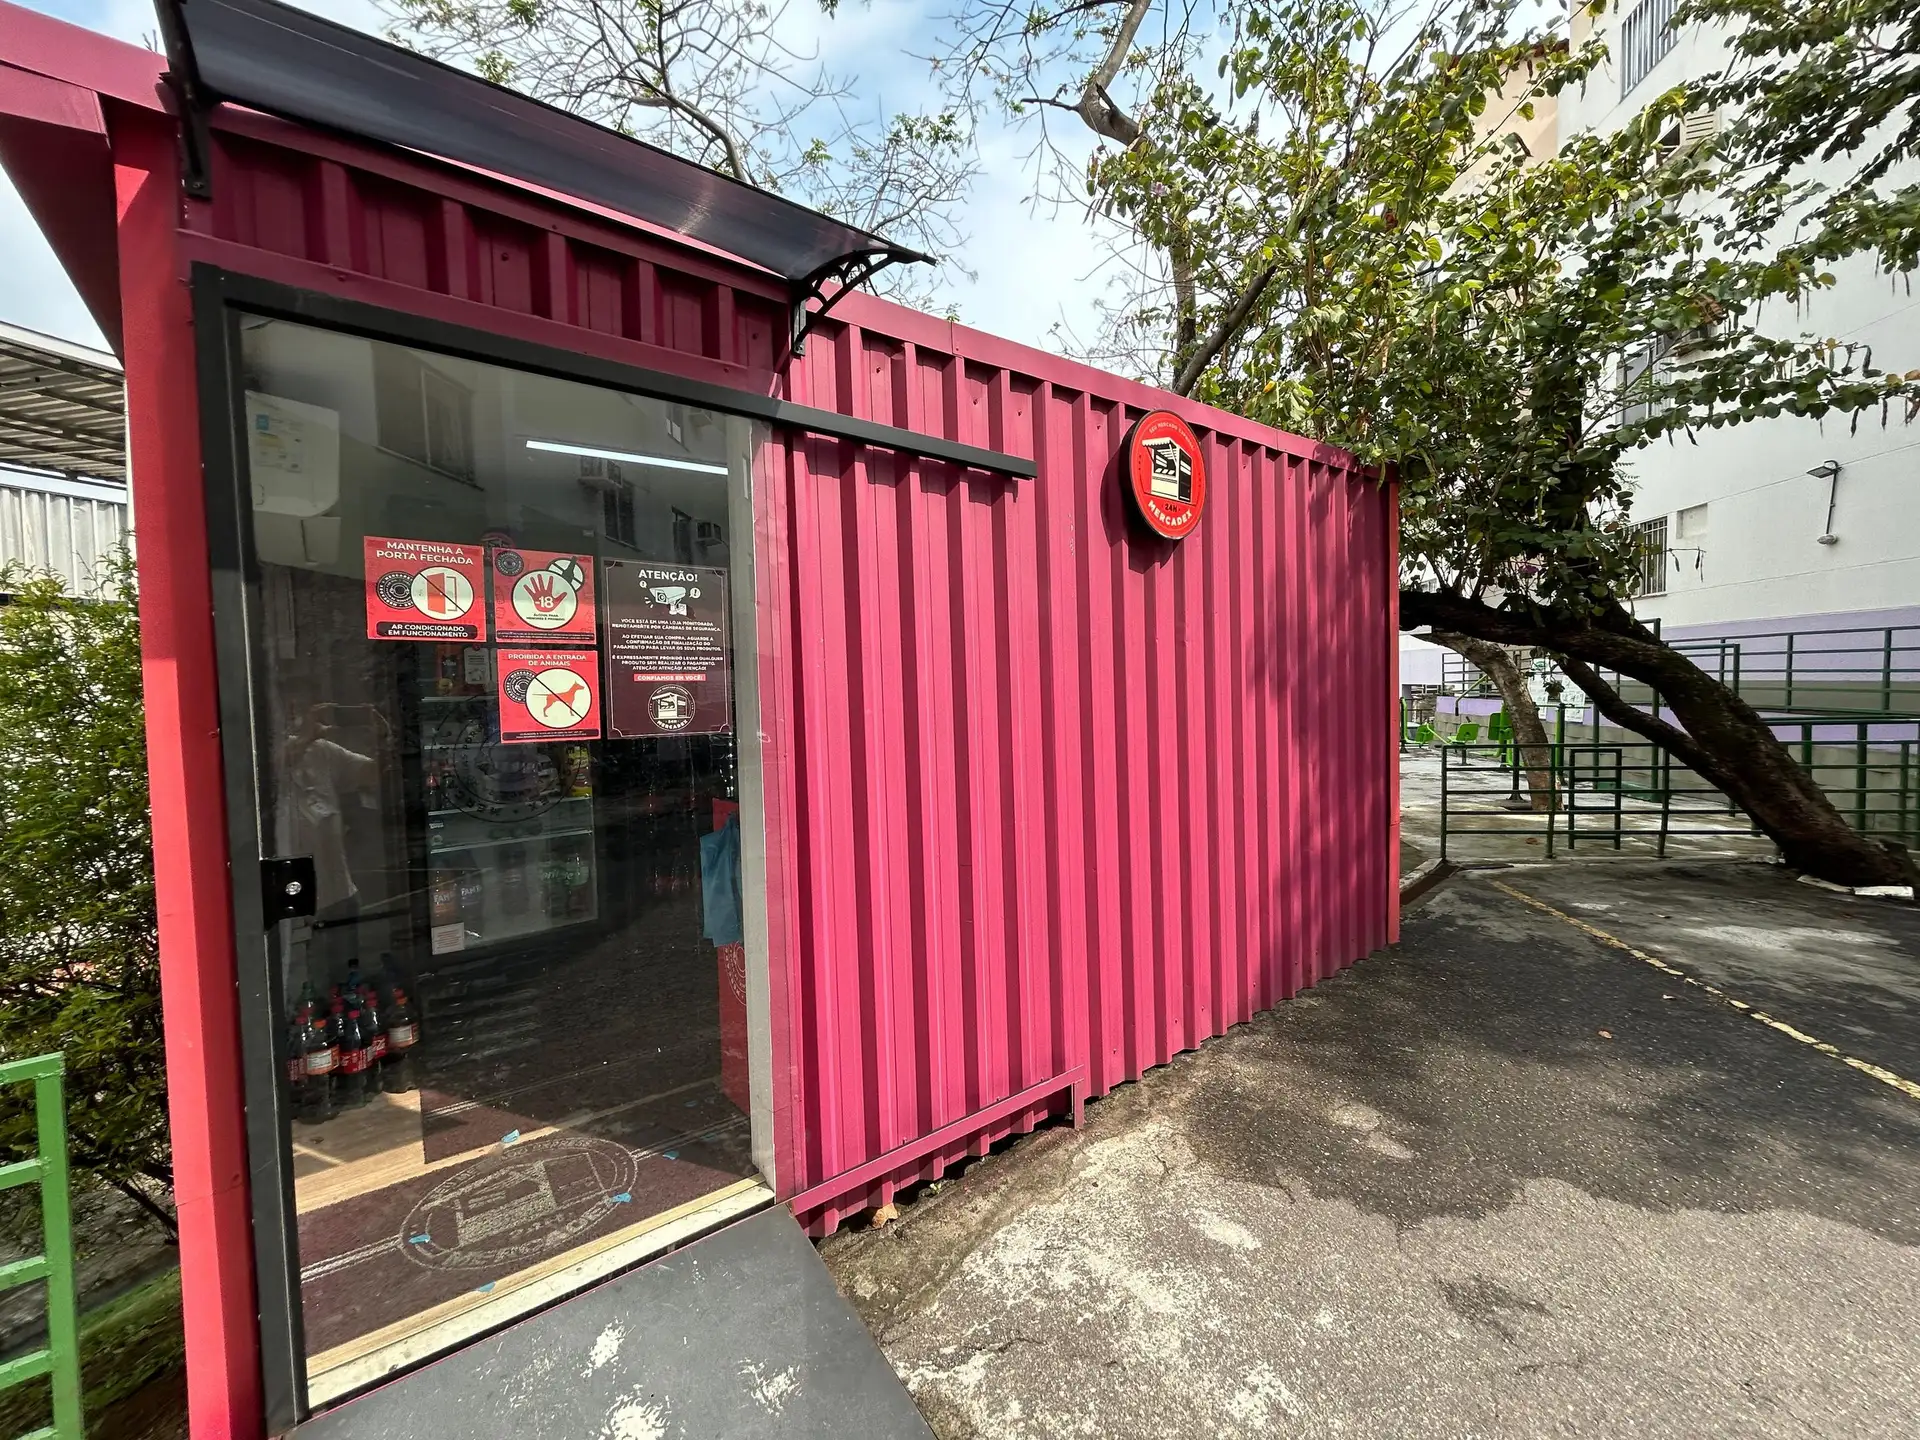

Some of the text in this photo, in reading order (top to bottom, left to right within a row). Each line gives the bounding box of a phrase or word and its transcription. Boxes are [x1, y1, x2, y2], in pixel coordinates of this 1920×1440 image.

[1148, 500, 1192, 526] MERCADEX
[1165, 503, 1178, 512] 24H
[386, 541, 464, 555] MANTENHA A
[376, 550, 473, 565] PORTA FECHADA
[638, 569, 698, 582] ATENÇÃO!
[404, 624, 464, 632] CONDICIONADO
